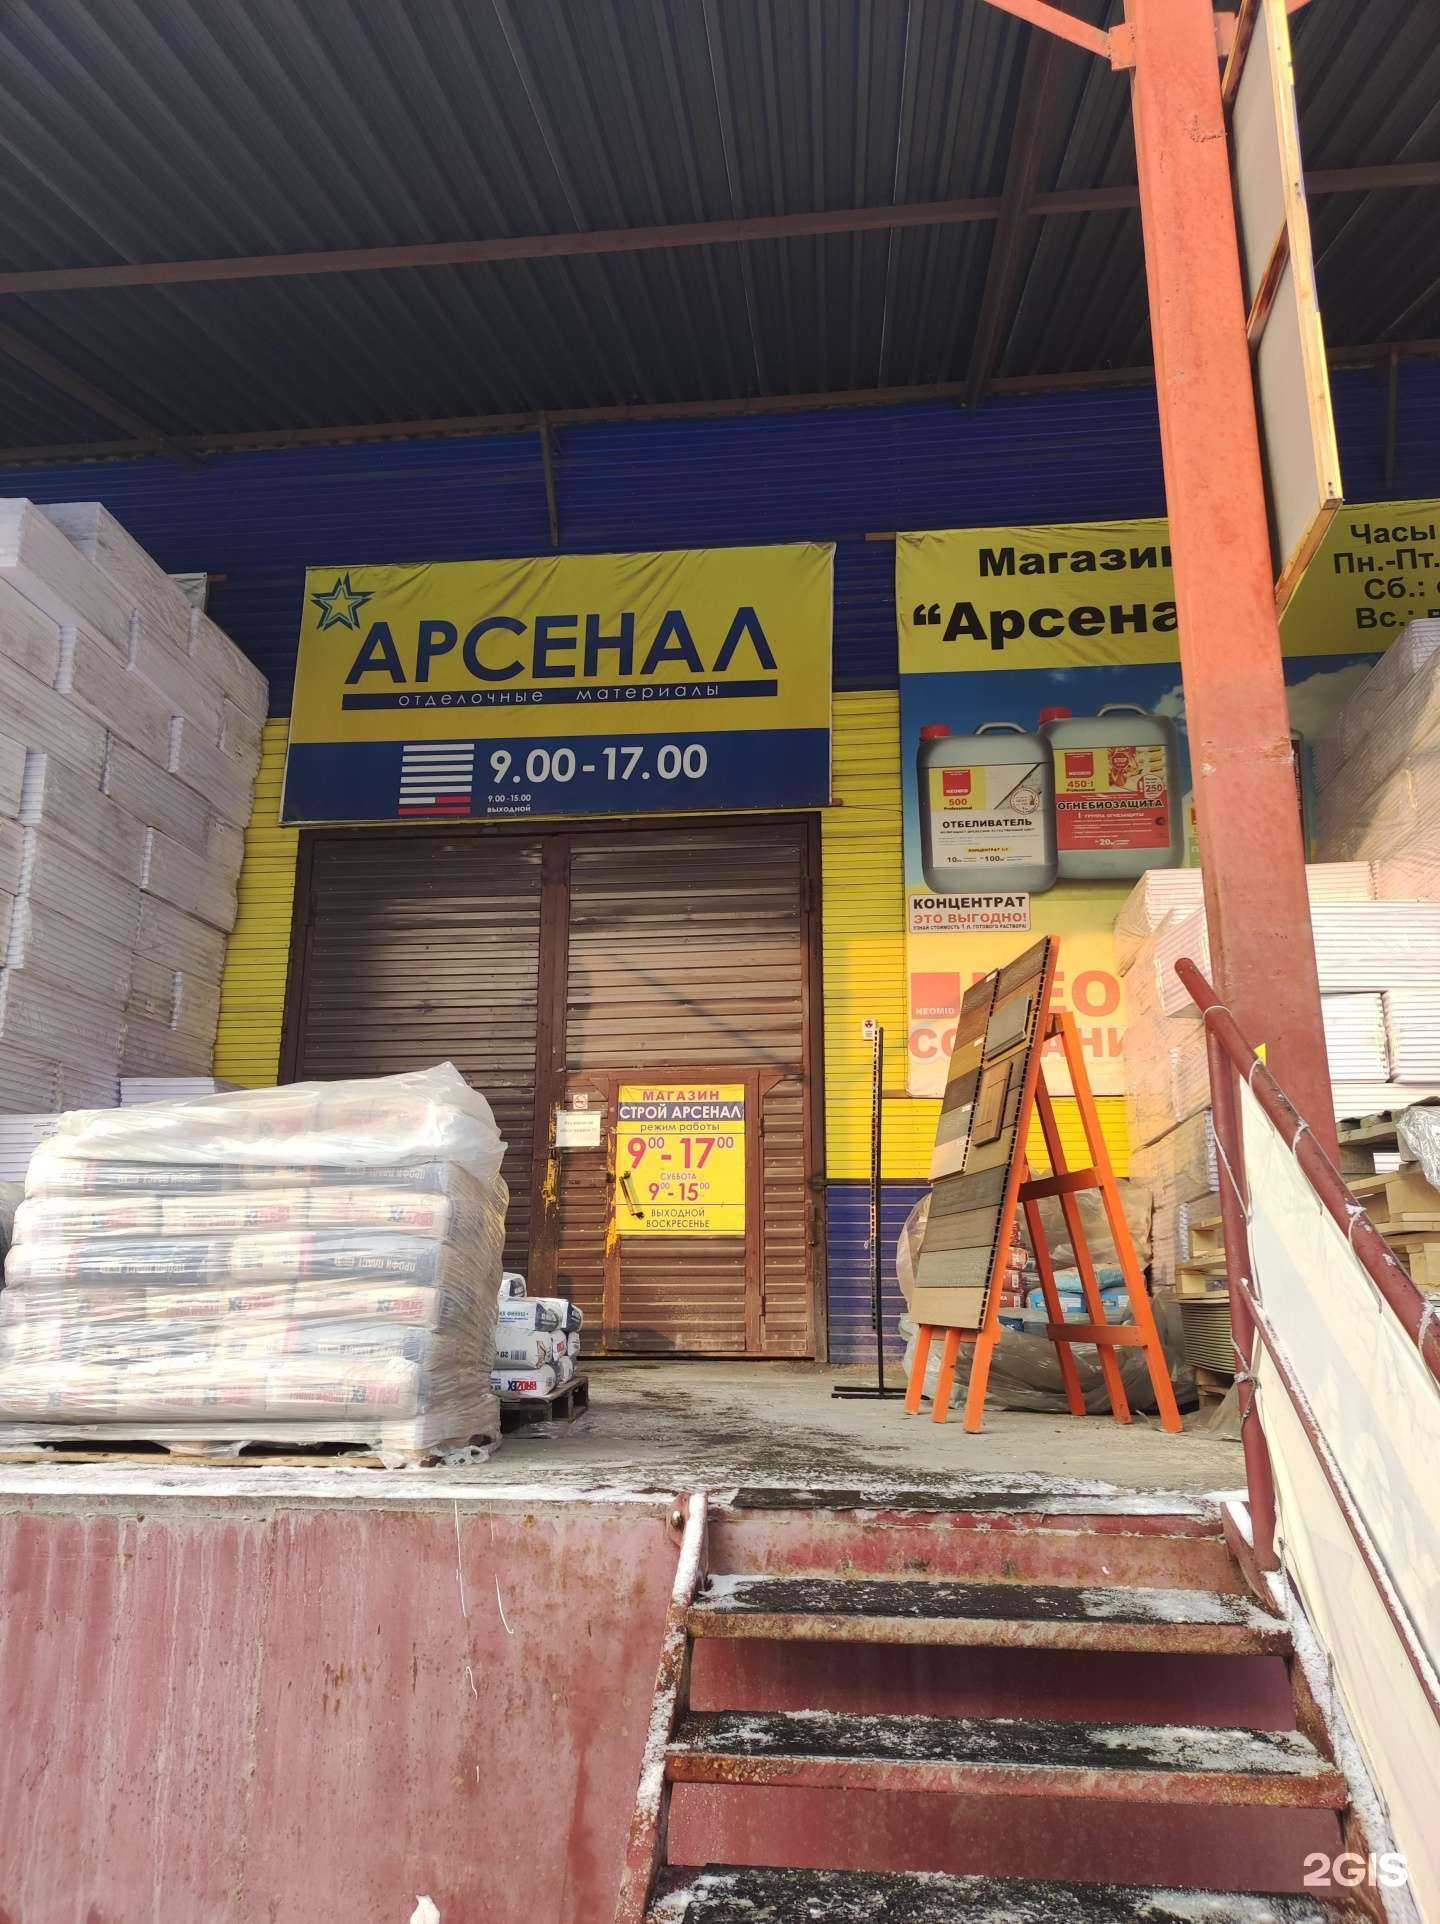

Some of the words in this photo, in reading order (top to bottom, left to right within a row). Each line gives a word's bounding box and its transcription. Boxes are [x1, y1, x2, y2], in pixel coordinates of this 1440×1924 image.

[1350, 523, 1436, 544] Часы
[344, 606, 777, 685] АРСЕНАЛ
[398, 691, 544, 706] отделочные
[575, 684, 719, 701] материалы
[948, 798, 968, 806] 500
[1057, 799, 1164, 809] ОГНЕБИОЗАЩИТА
[942, 818, 1033, 829] ОТБЕЛИВАТЕЛЬ
[913, 896, 1026, 910] КОНЦЕНТРАТ
[914, 913, 943, 924] ЭТО
[948, 911, 1028, 924] ВЫГОДНО!
[643, 1090, 720, 1101] МАГАЗИН
[619, 1103, 668, 1119] СТРОЙ
[671, 1105, 742, 1119] АРСЕНАЛ
[640, 1125, 676, 1133] режим
[679, 1123, 720, 1131] работы
[660, 1172, 697, 1181] СУББОТА
[651, 1207, 705, 1218] ВЫХОДНОЙ
[646, 1219, 711, 1228] ВОСКРЕСЕНЬЕ
